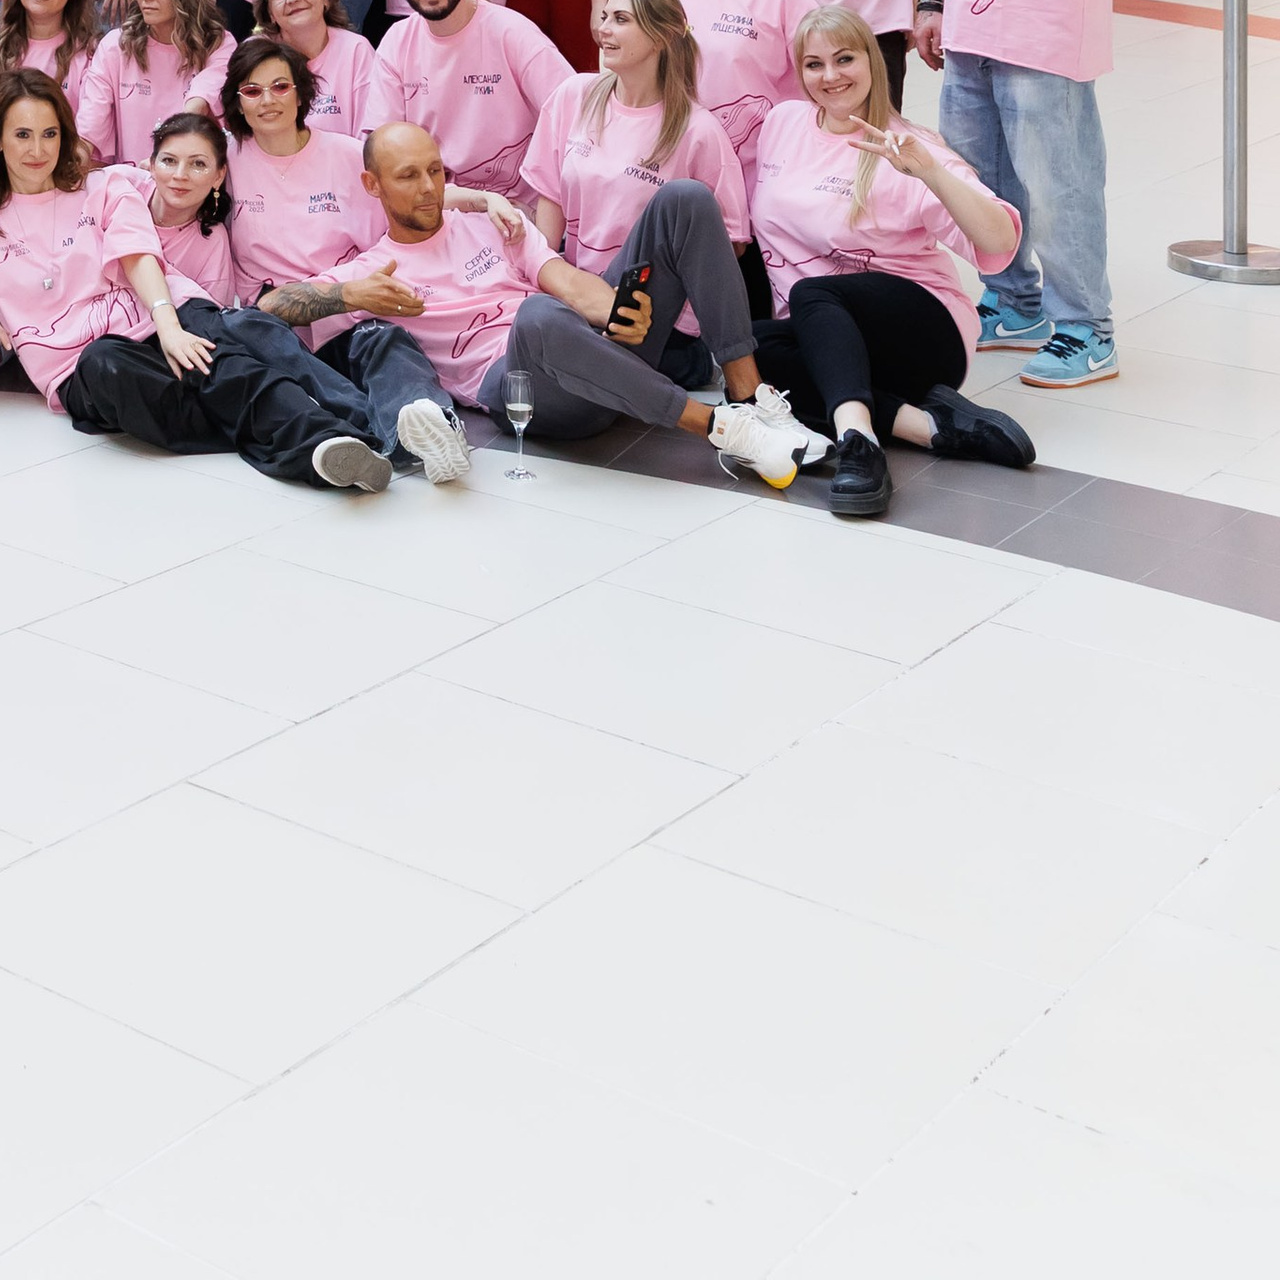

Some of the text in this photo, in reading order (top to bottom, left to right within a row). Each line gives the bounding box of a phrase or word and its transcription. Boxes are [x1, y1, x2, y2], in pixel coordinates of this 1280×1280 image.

[721, 13, 753, 26] ПОЛИНА
[463, 75, 502, 85] АЛЕКСАНДР
[309, 192, 337, 203] МАРИНА
[308, 203, 341, 214] БЕЛЯЕВА
